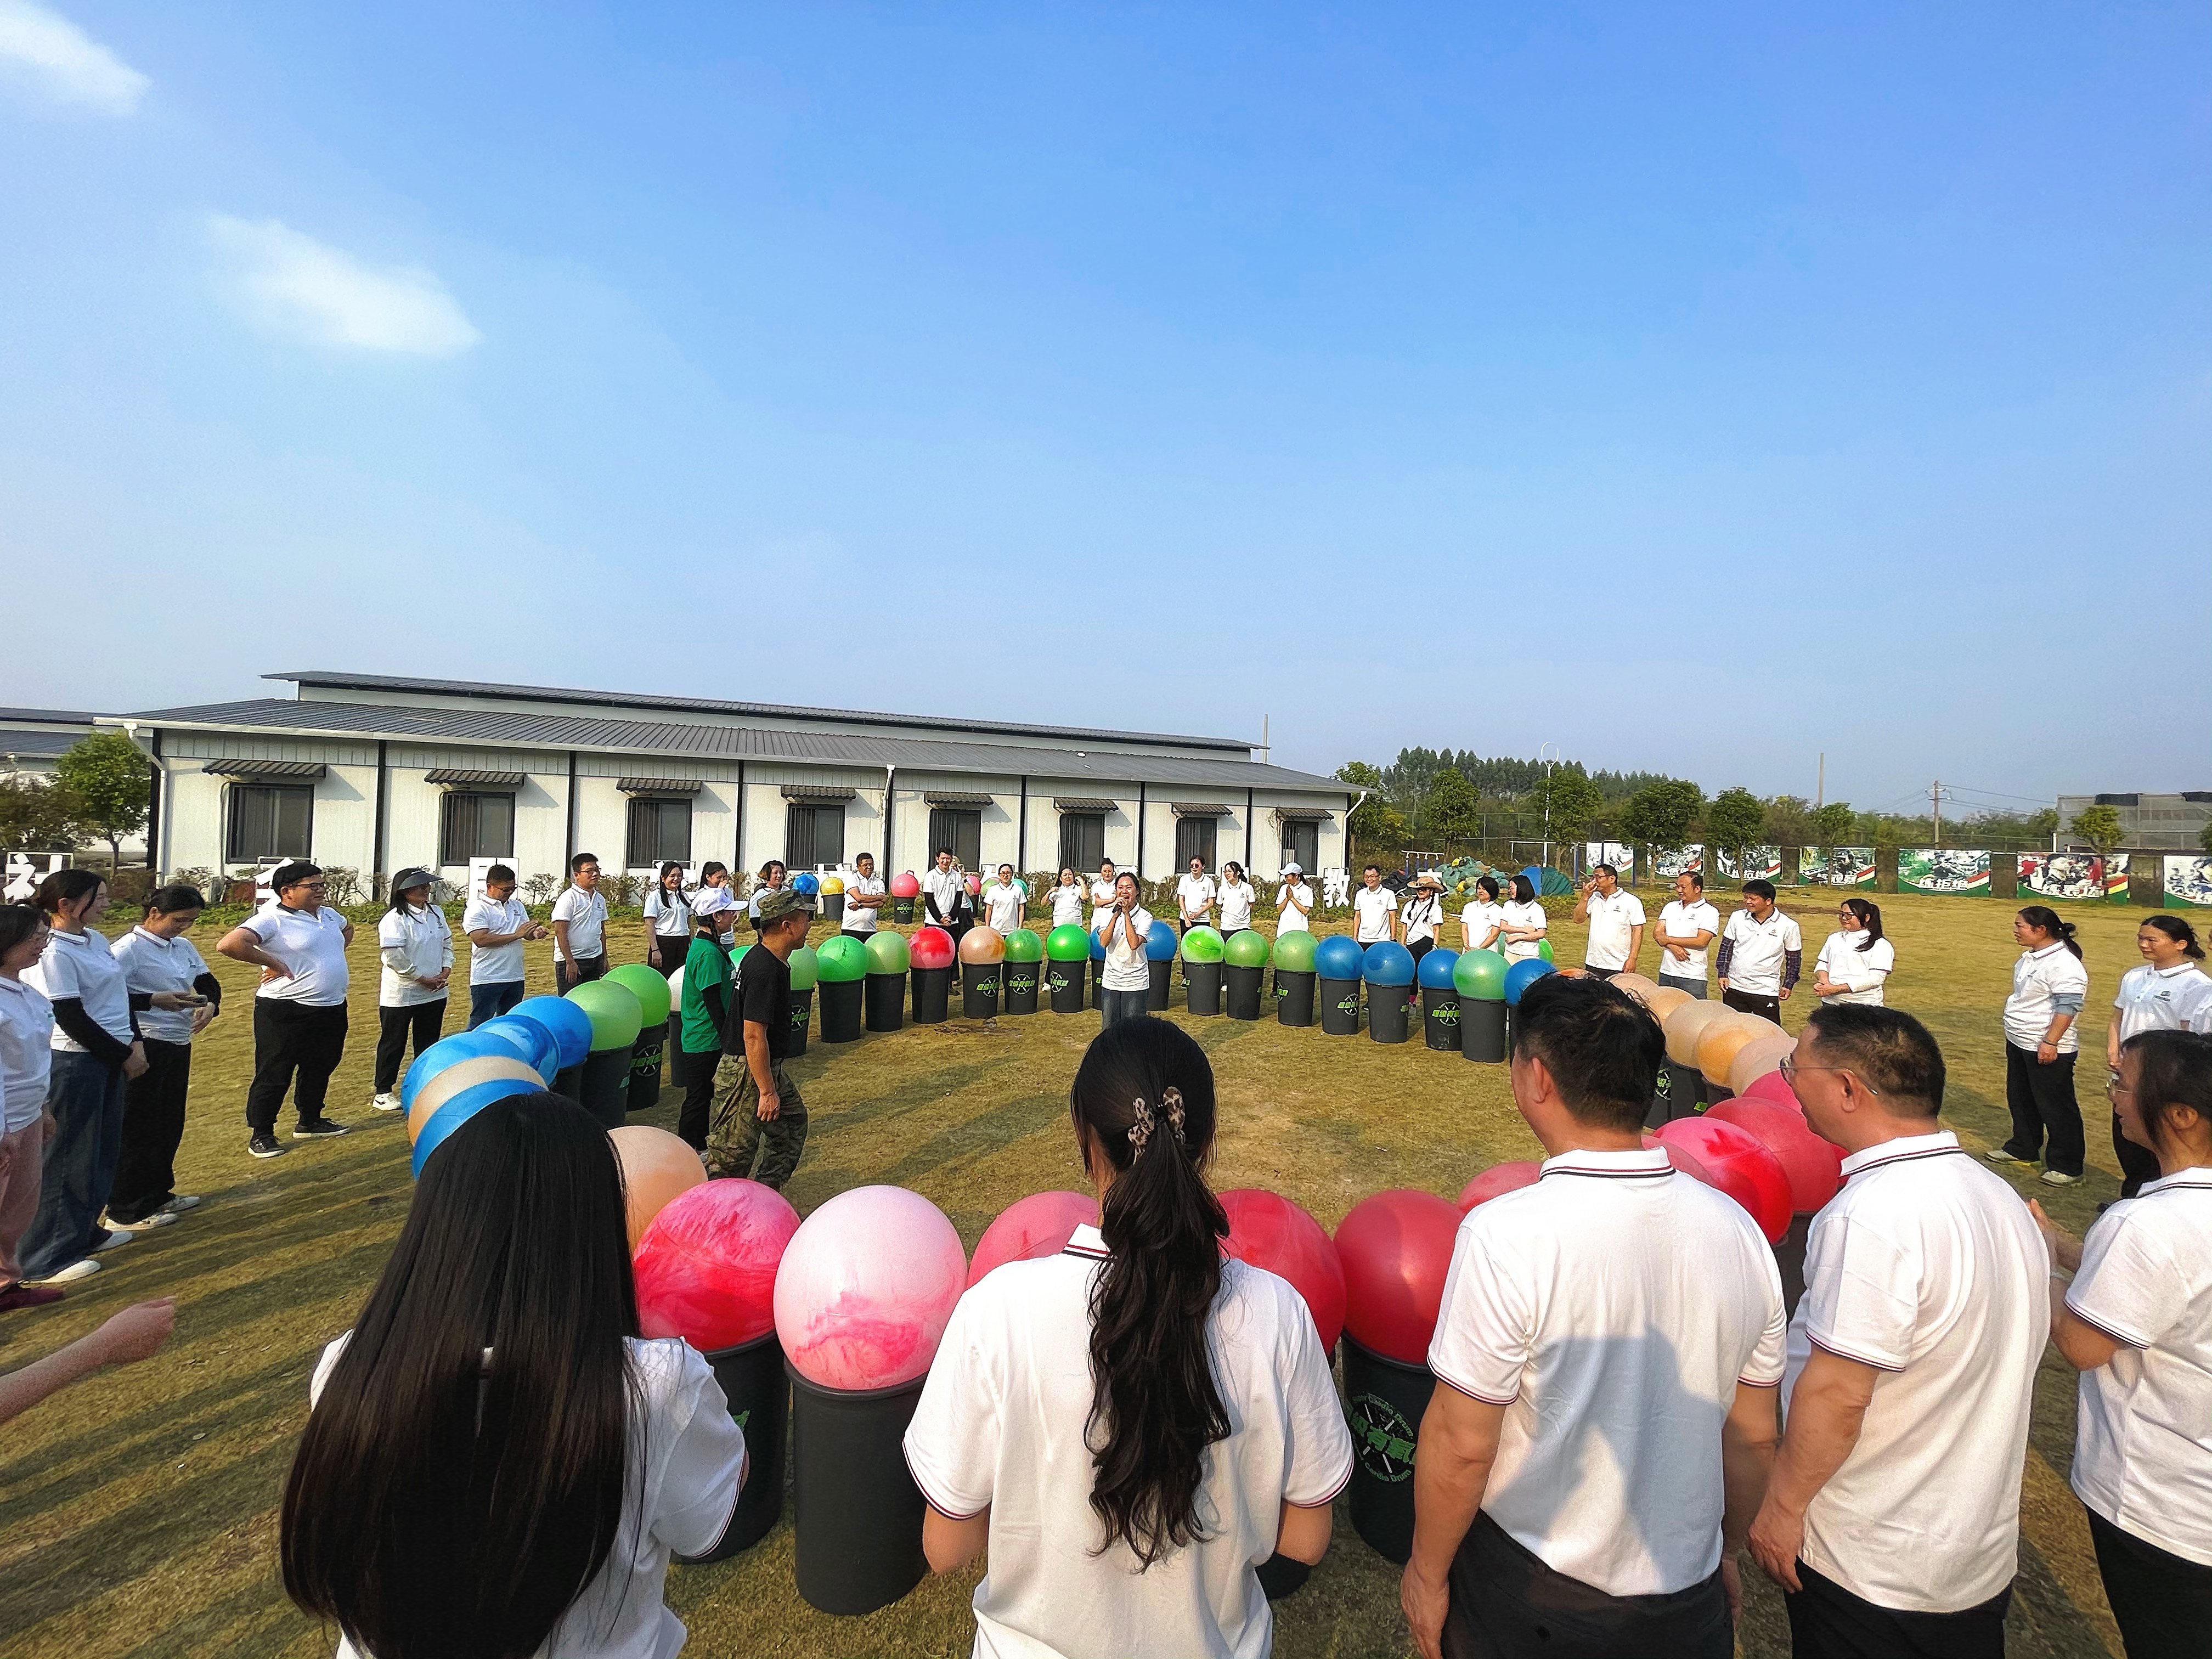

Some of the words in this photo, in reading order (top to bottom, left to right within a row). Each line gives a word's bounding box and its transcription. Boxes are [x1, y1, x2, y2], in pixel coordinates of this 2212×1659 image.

[1323, 868, 1351, 909] 教
[1920, 878, 1968, 890] 练拒绝
[2042, 884, 2102, 898] 练表达
